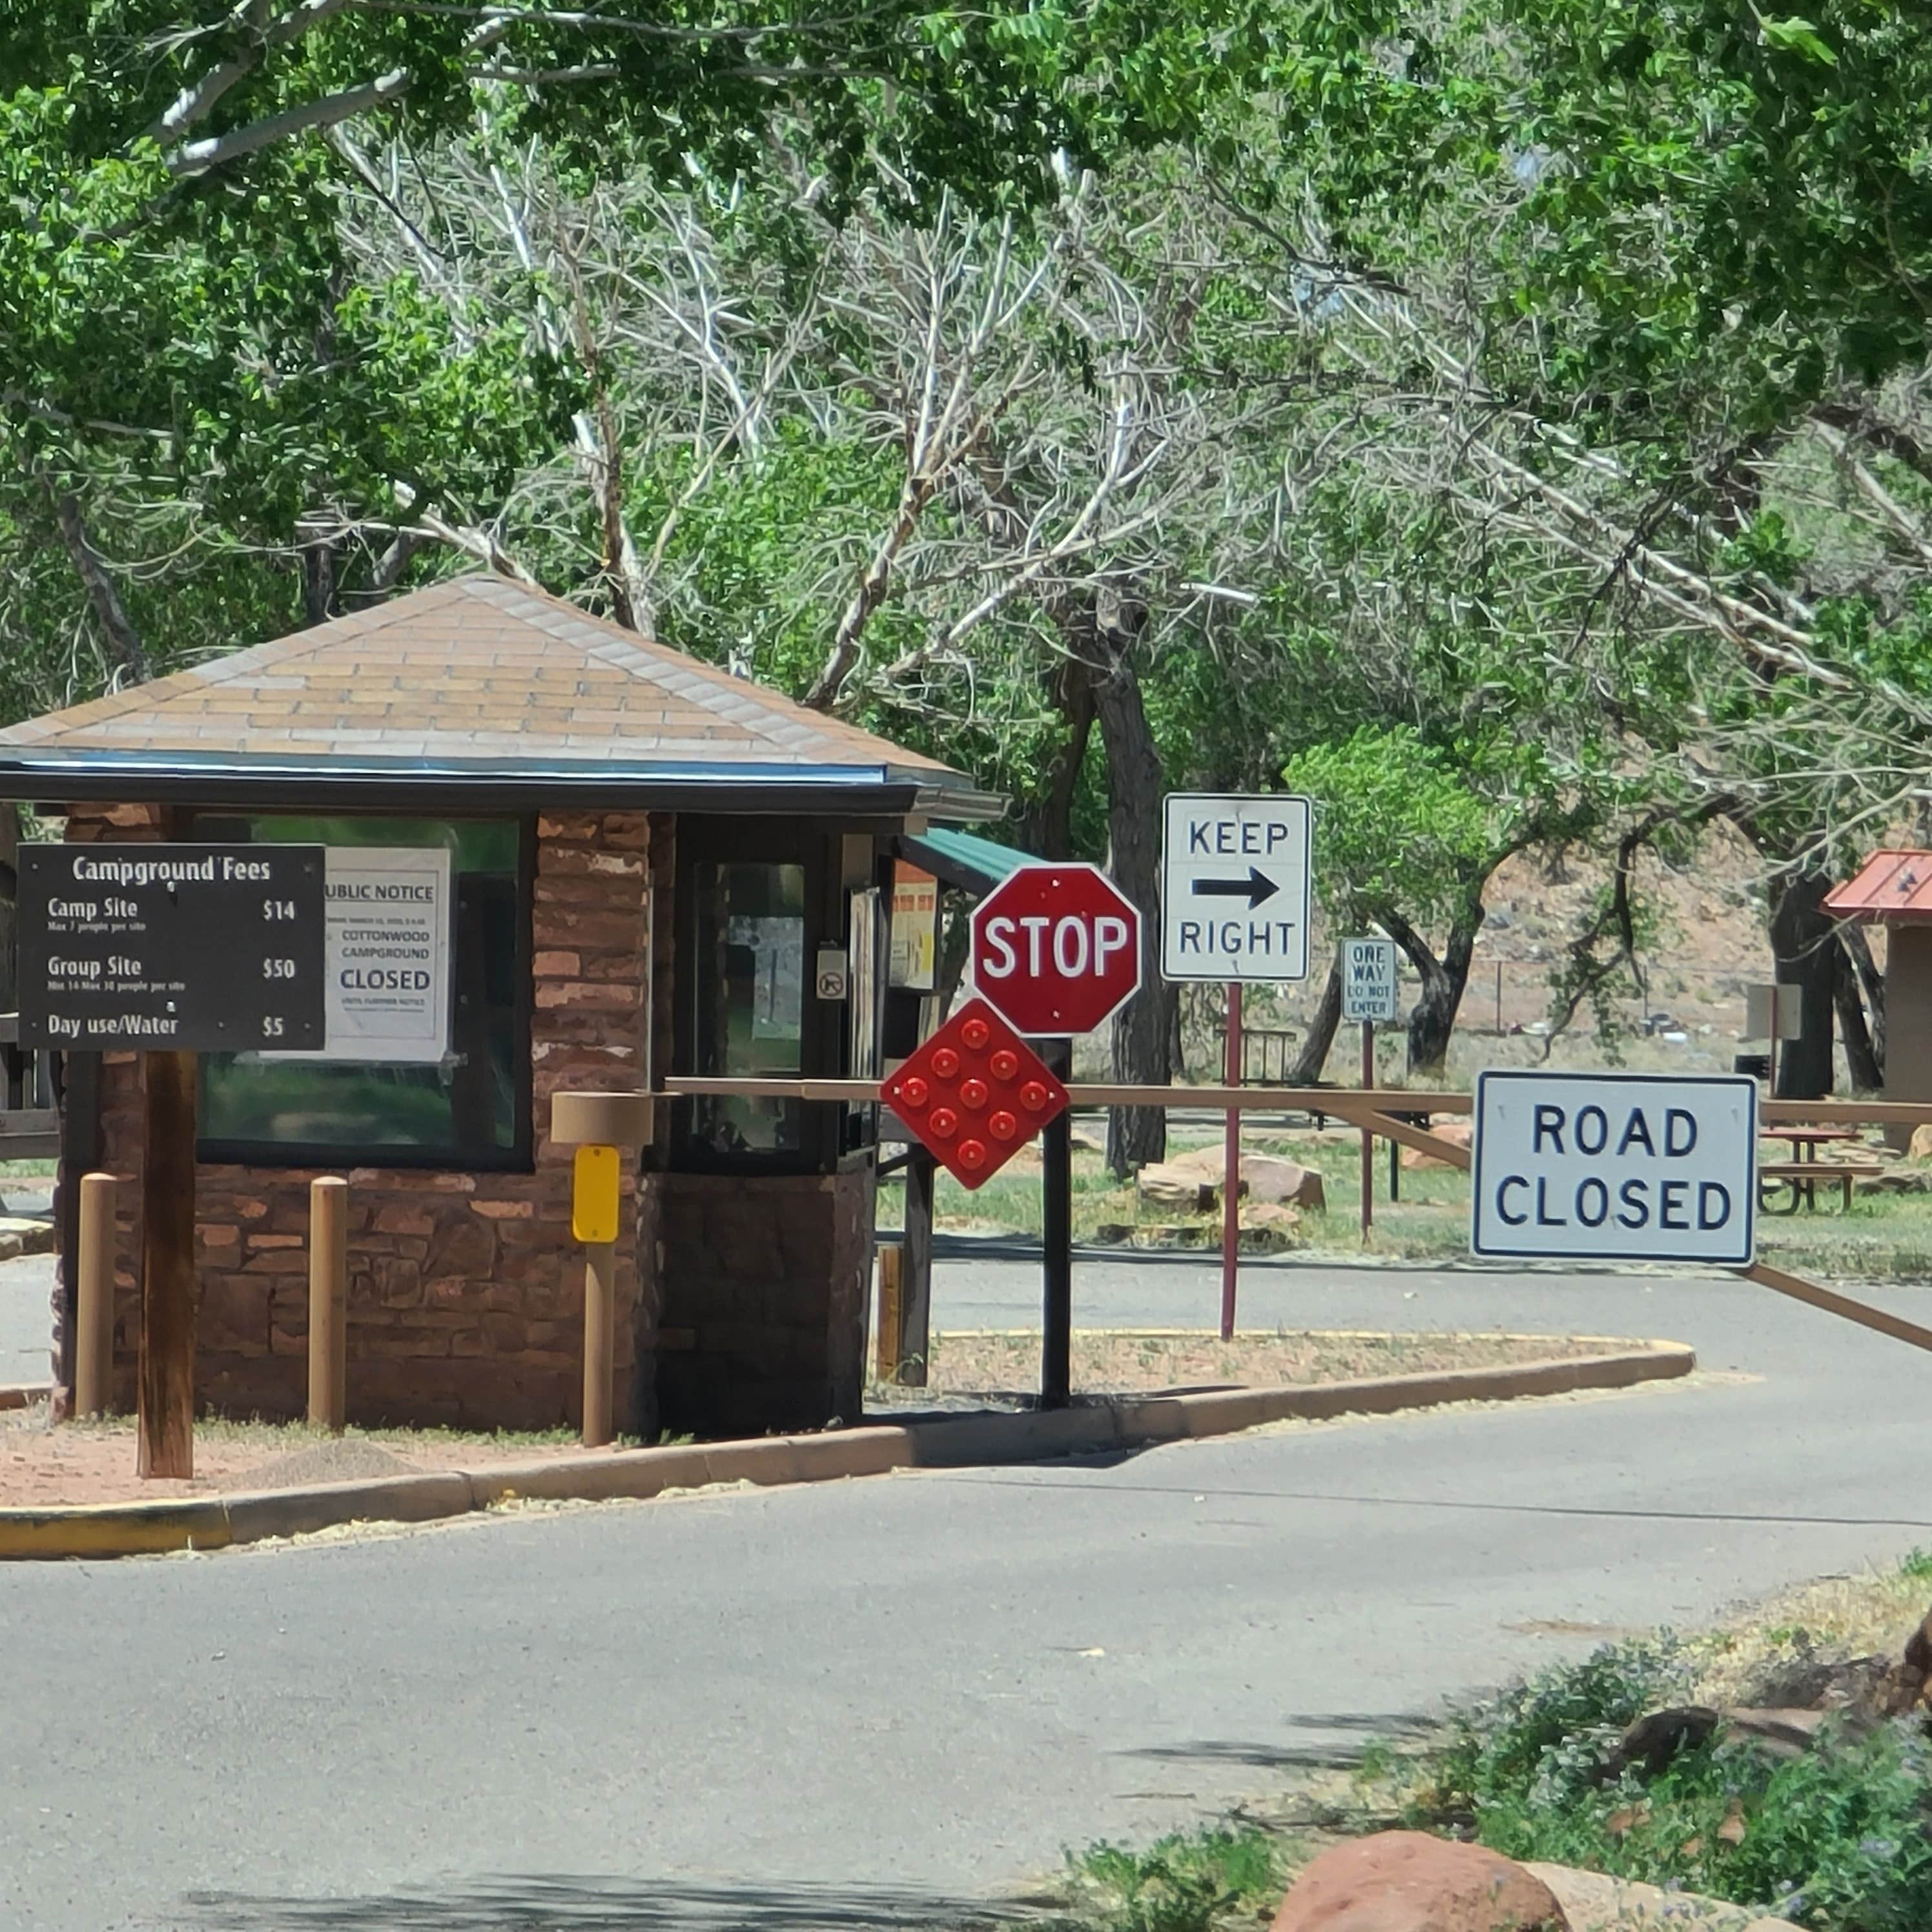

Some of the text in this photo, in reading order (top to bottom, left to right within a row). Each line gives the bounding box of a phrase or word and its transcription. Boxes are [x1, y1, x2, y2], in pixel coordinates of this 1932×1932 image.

[1190, 821, 1288, 854] KEEP
[73, 856, 271, 885] Campground Fees
[325, 884, 434, 899] UBLIC NOTICE
[48, 898, 138, 921] Camp Site
[263, 900, 295, 920] $14
[342, 930, 429, 941] COTTONWOOD
[1180, 921, 1295, 955] RIGHT
[342, 947, 429, 959] CAMPGROUND
[982, 916, 1127, 978] STOP
[1353, 945, 1385, 963] ONE
[48, 956, 141, 980] Group Site
[263, 959, 295, 978] $50
[1353, 965, 1385, 981] WAY
[340, 969, 430, 990] CLOSED
[1348, 985, 1389, 997] DO NOT
[1351, 1002, 1386, 1013] ENTER
[48, 1015, 179, 1038] Day use/Water
[263, 1018, 284, 1036] $5
[1533, 1105, 1698, 1157] ROAD
[1496, 1175, 1731, 1230] CLOSED
